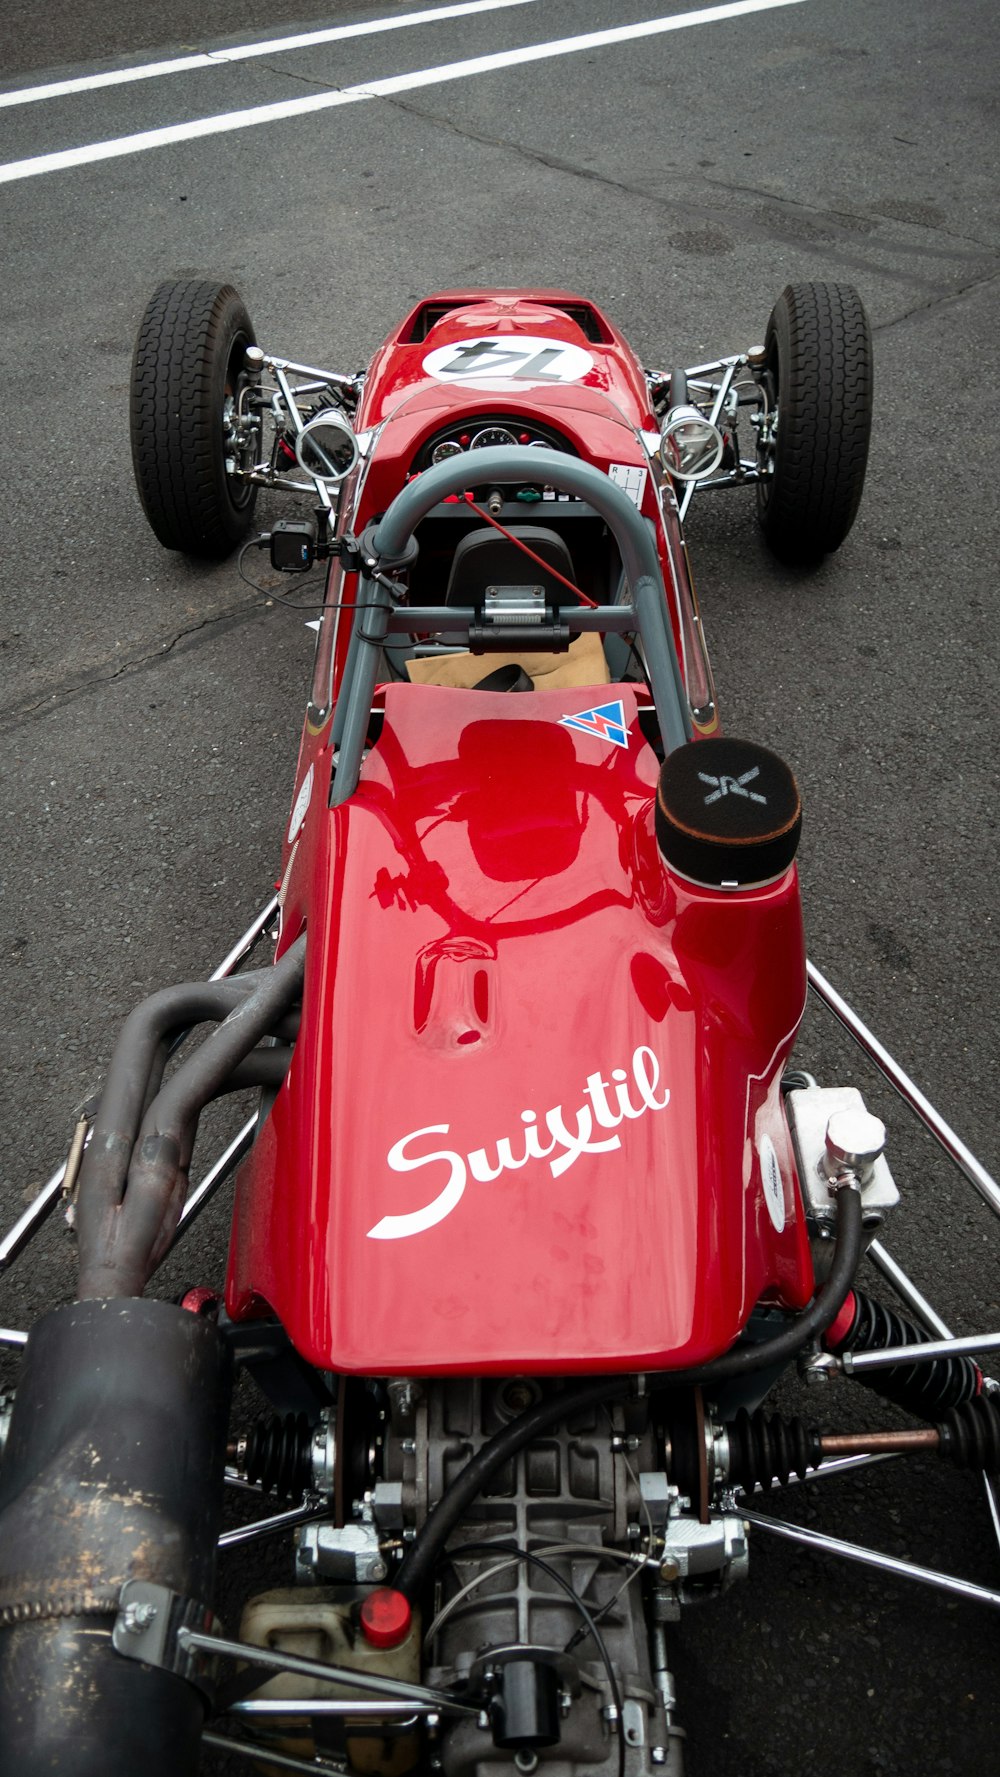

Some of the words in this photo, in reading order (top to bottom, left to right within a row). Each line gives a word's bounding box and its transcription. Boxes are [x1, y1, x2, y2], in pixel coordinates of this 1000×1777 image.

[439, 341, 565, 381] 74
[612, 466, 618, 474] R
[366, 1045, 671, 1240] Suixtil
